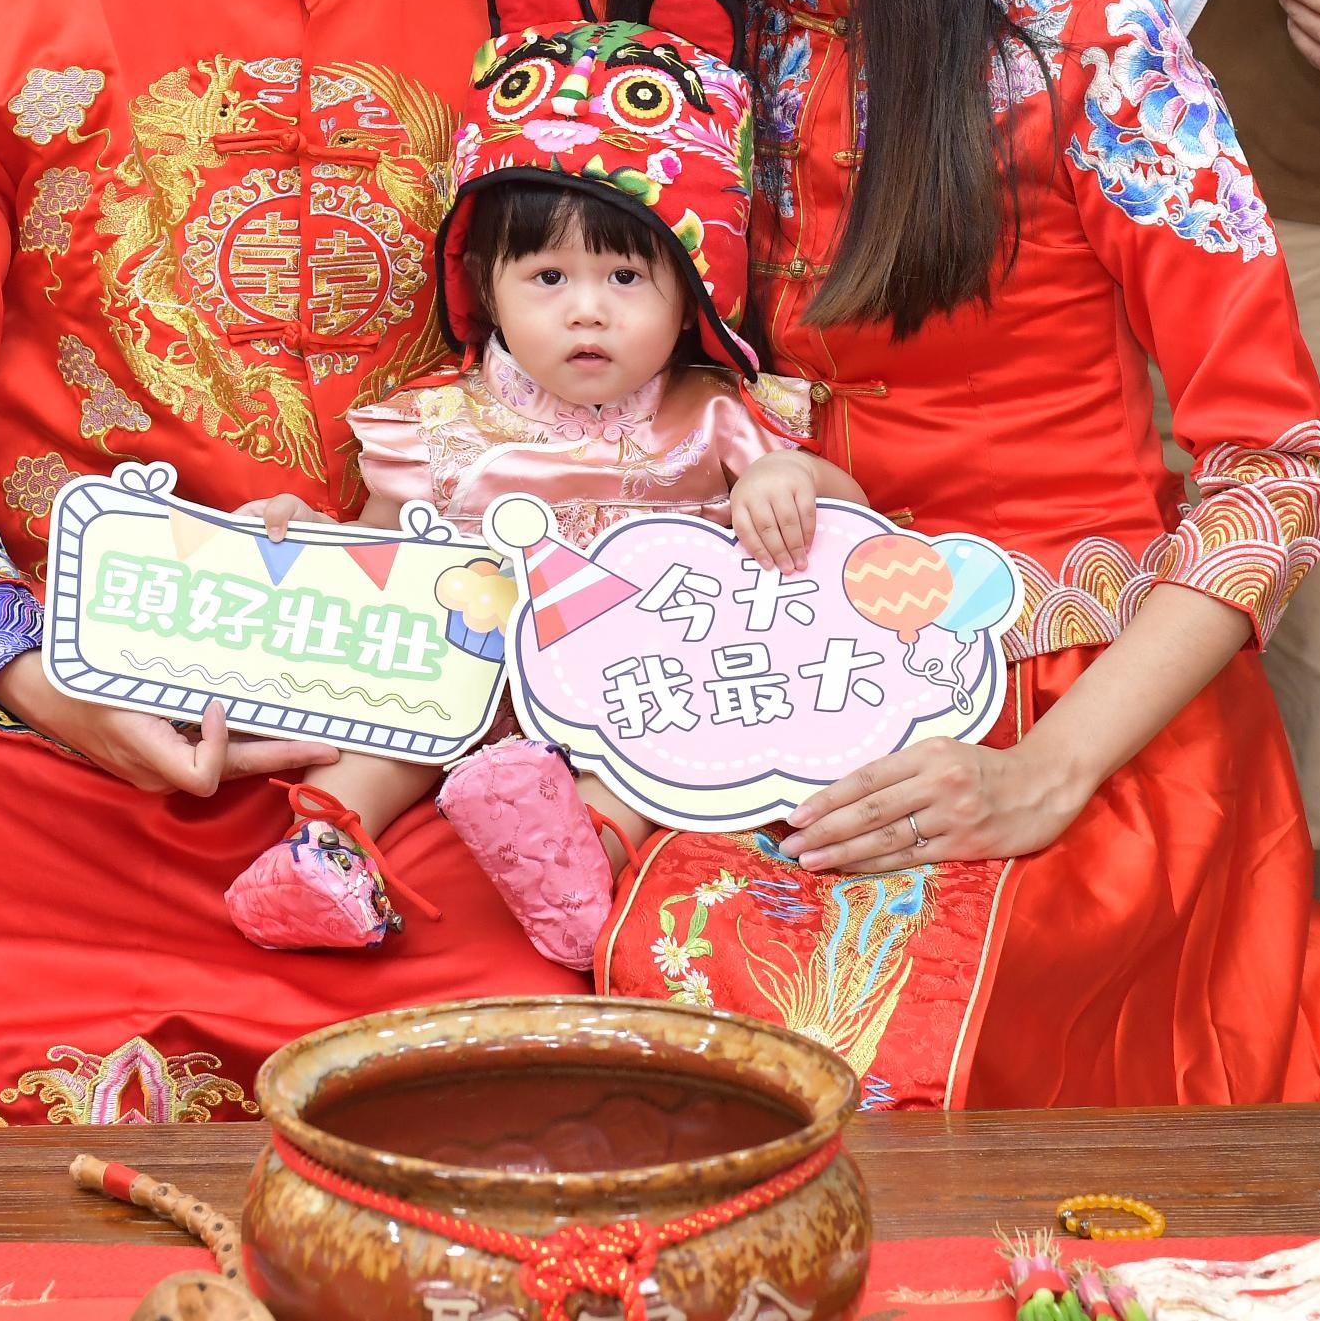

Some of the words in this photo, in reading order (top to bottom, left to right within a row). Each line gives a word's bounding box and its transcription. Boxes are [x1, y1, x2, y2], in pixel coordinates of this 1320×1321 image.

[92, 555, 438, 677] 頭好壯壯
[636, 556, 820, 643] 今天
[602, 637, 886, 740] 我最大
